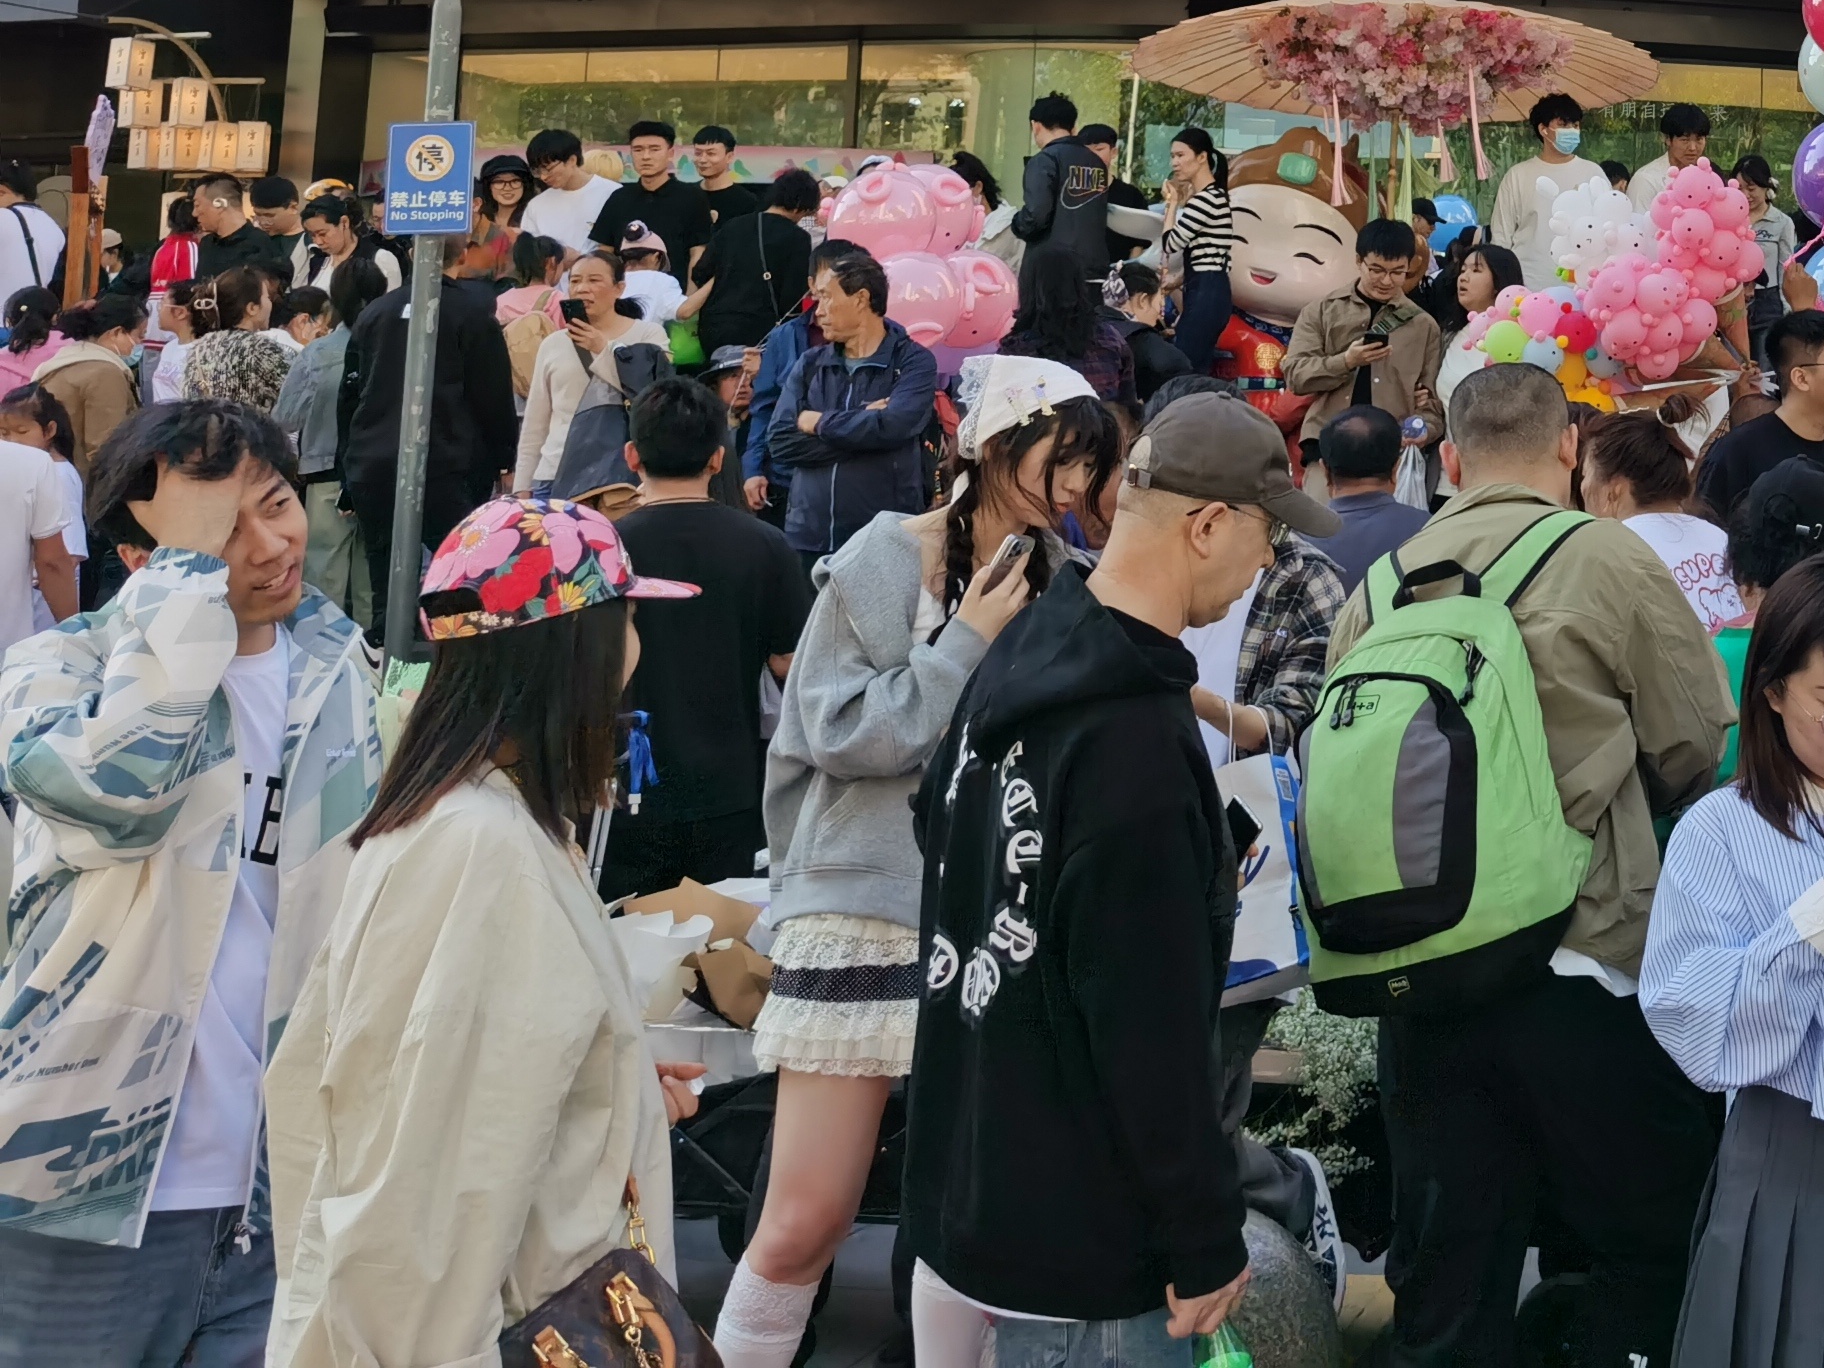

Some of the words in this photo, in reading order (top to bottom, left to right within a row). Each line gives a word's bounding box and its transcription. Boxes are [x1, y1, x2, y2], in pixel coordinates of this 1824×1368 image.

[1069, 166, 1105, 191] NIKE
[390, 190, 466, 208] 禁止停车
[390, 212, 407, 220] No
[410, 210, 464, 221] Stopping
